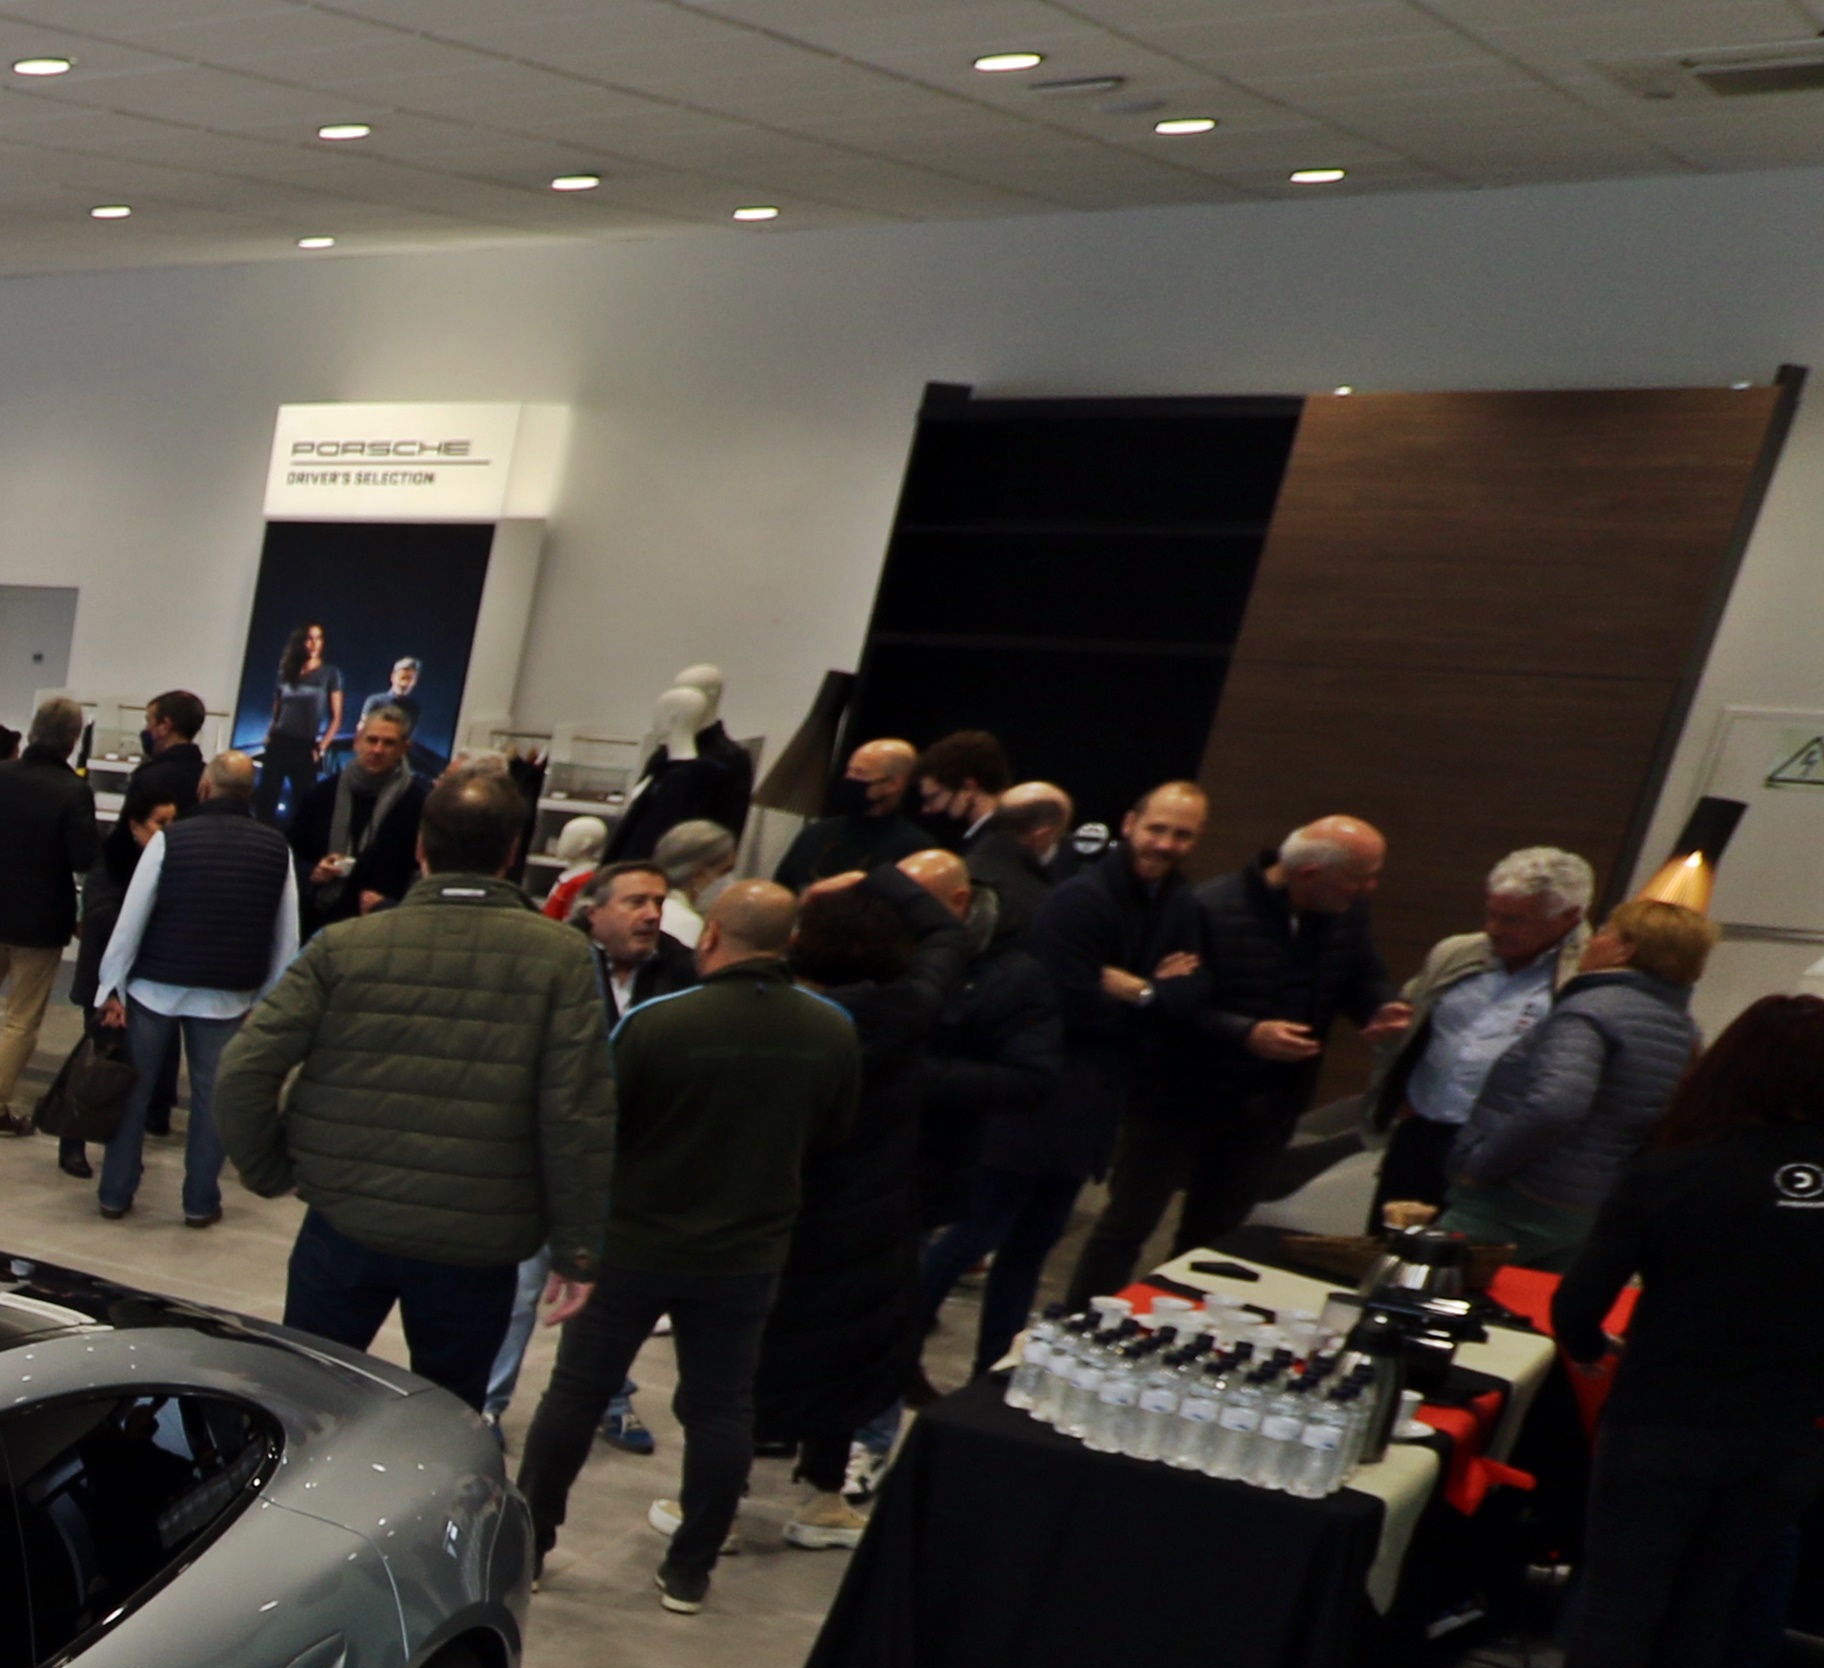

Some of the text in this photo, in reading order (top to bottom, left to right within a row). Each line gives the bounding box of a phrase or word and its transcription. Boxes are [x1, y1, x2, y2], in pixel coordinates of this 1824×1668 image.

[291, 440, 471, 457] PORSCHE
[286, 471, 436, 485] DRIVER'S SELECTION
